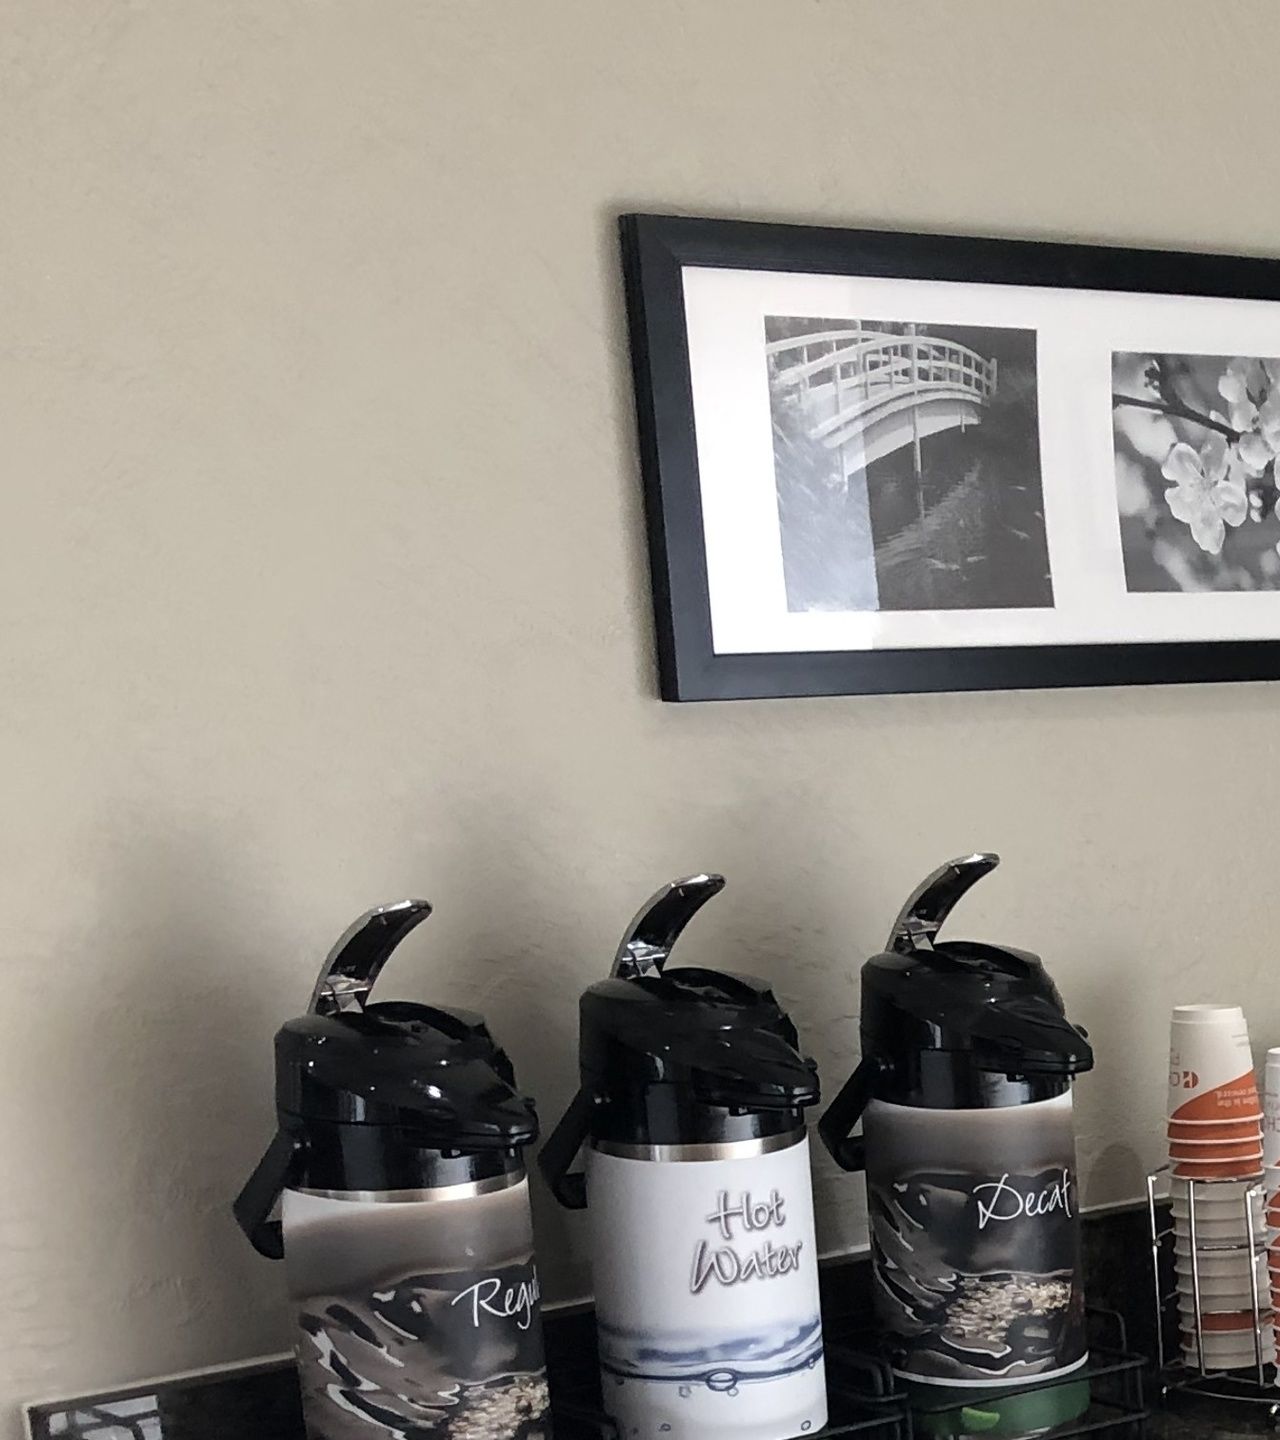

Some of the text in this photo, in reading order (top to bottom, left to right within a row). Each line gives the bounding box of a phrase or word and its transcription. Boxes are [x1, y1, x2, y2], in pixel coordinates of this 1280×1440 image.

[707, 1190, 786, 1239] Hot
[973, 1168, 1072, 1229] Decaf
[690, 1240, 803, 1293] Water
